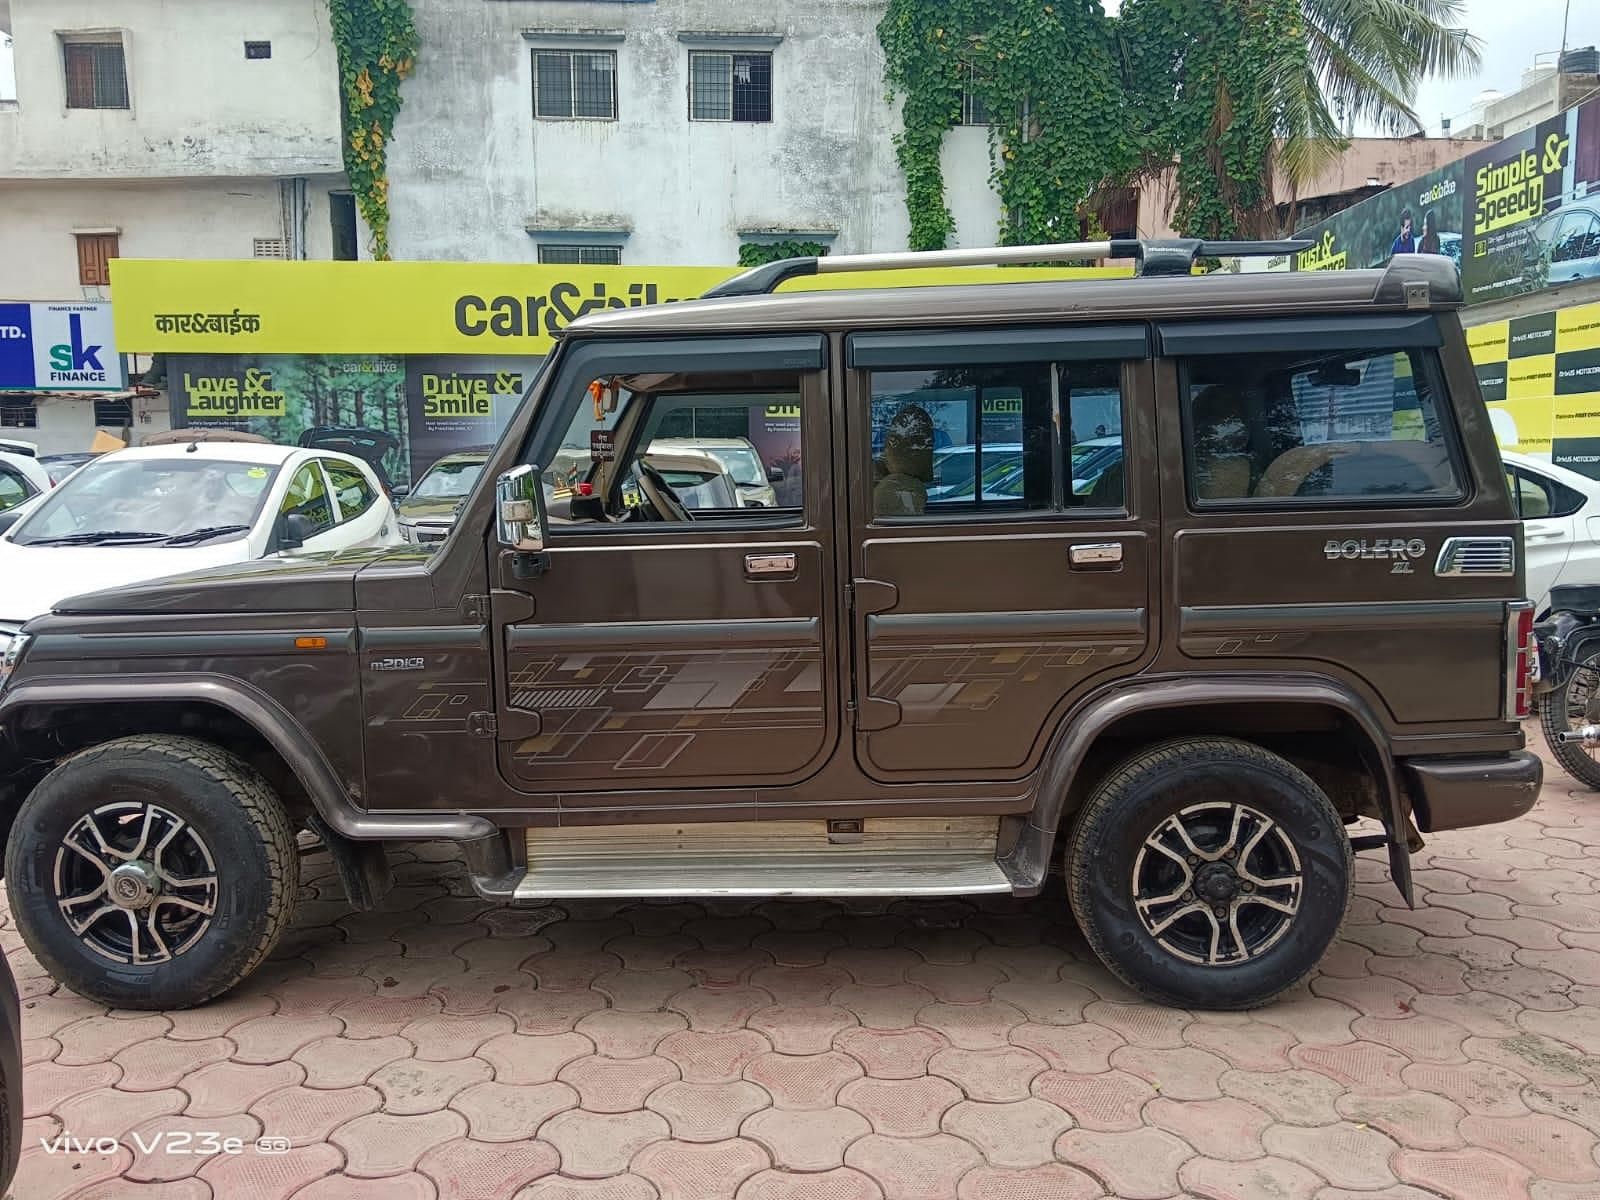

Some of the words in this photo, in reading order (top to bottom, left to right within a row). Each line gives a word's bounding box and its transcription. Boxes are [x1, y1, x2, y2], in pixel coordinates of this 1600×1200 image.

[1476, 149, 1537, 196] Simple
[1542, 133, 1569, 174] &
[1419, 179, 1456, 206] car&bike
[1475, 183, 1542, 230] Speedy
[154, 308, 260, 335] कार&बाईक
[49, 313, 104, 371] sk
[50, 372, 105, 382] FINANCE
[184, 373, 238, 393] Love
[245, 367, 272, 393] &
[422, 371, 487, 394] Drive
[494, 368, 521, 395] &
[188, 391, 283, 414] Laughter
[424, 394, 488, 414] Smile
[1324, 538, 1426, 560] BOLERO
